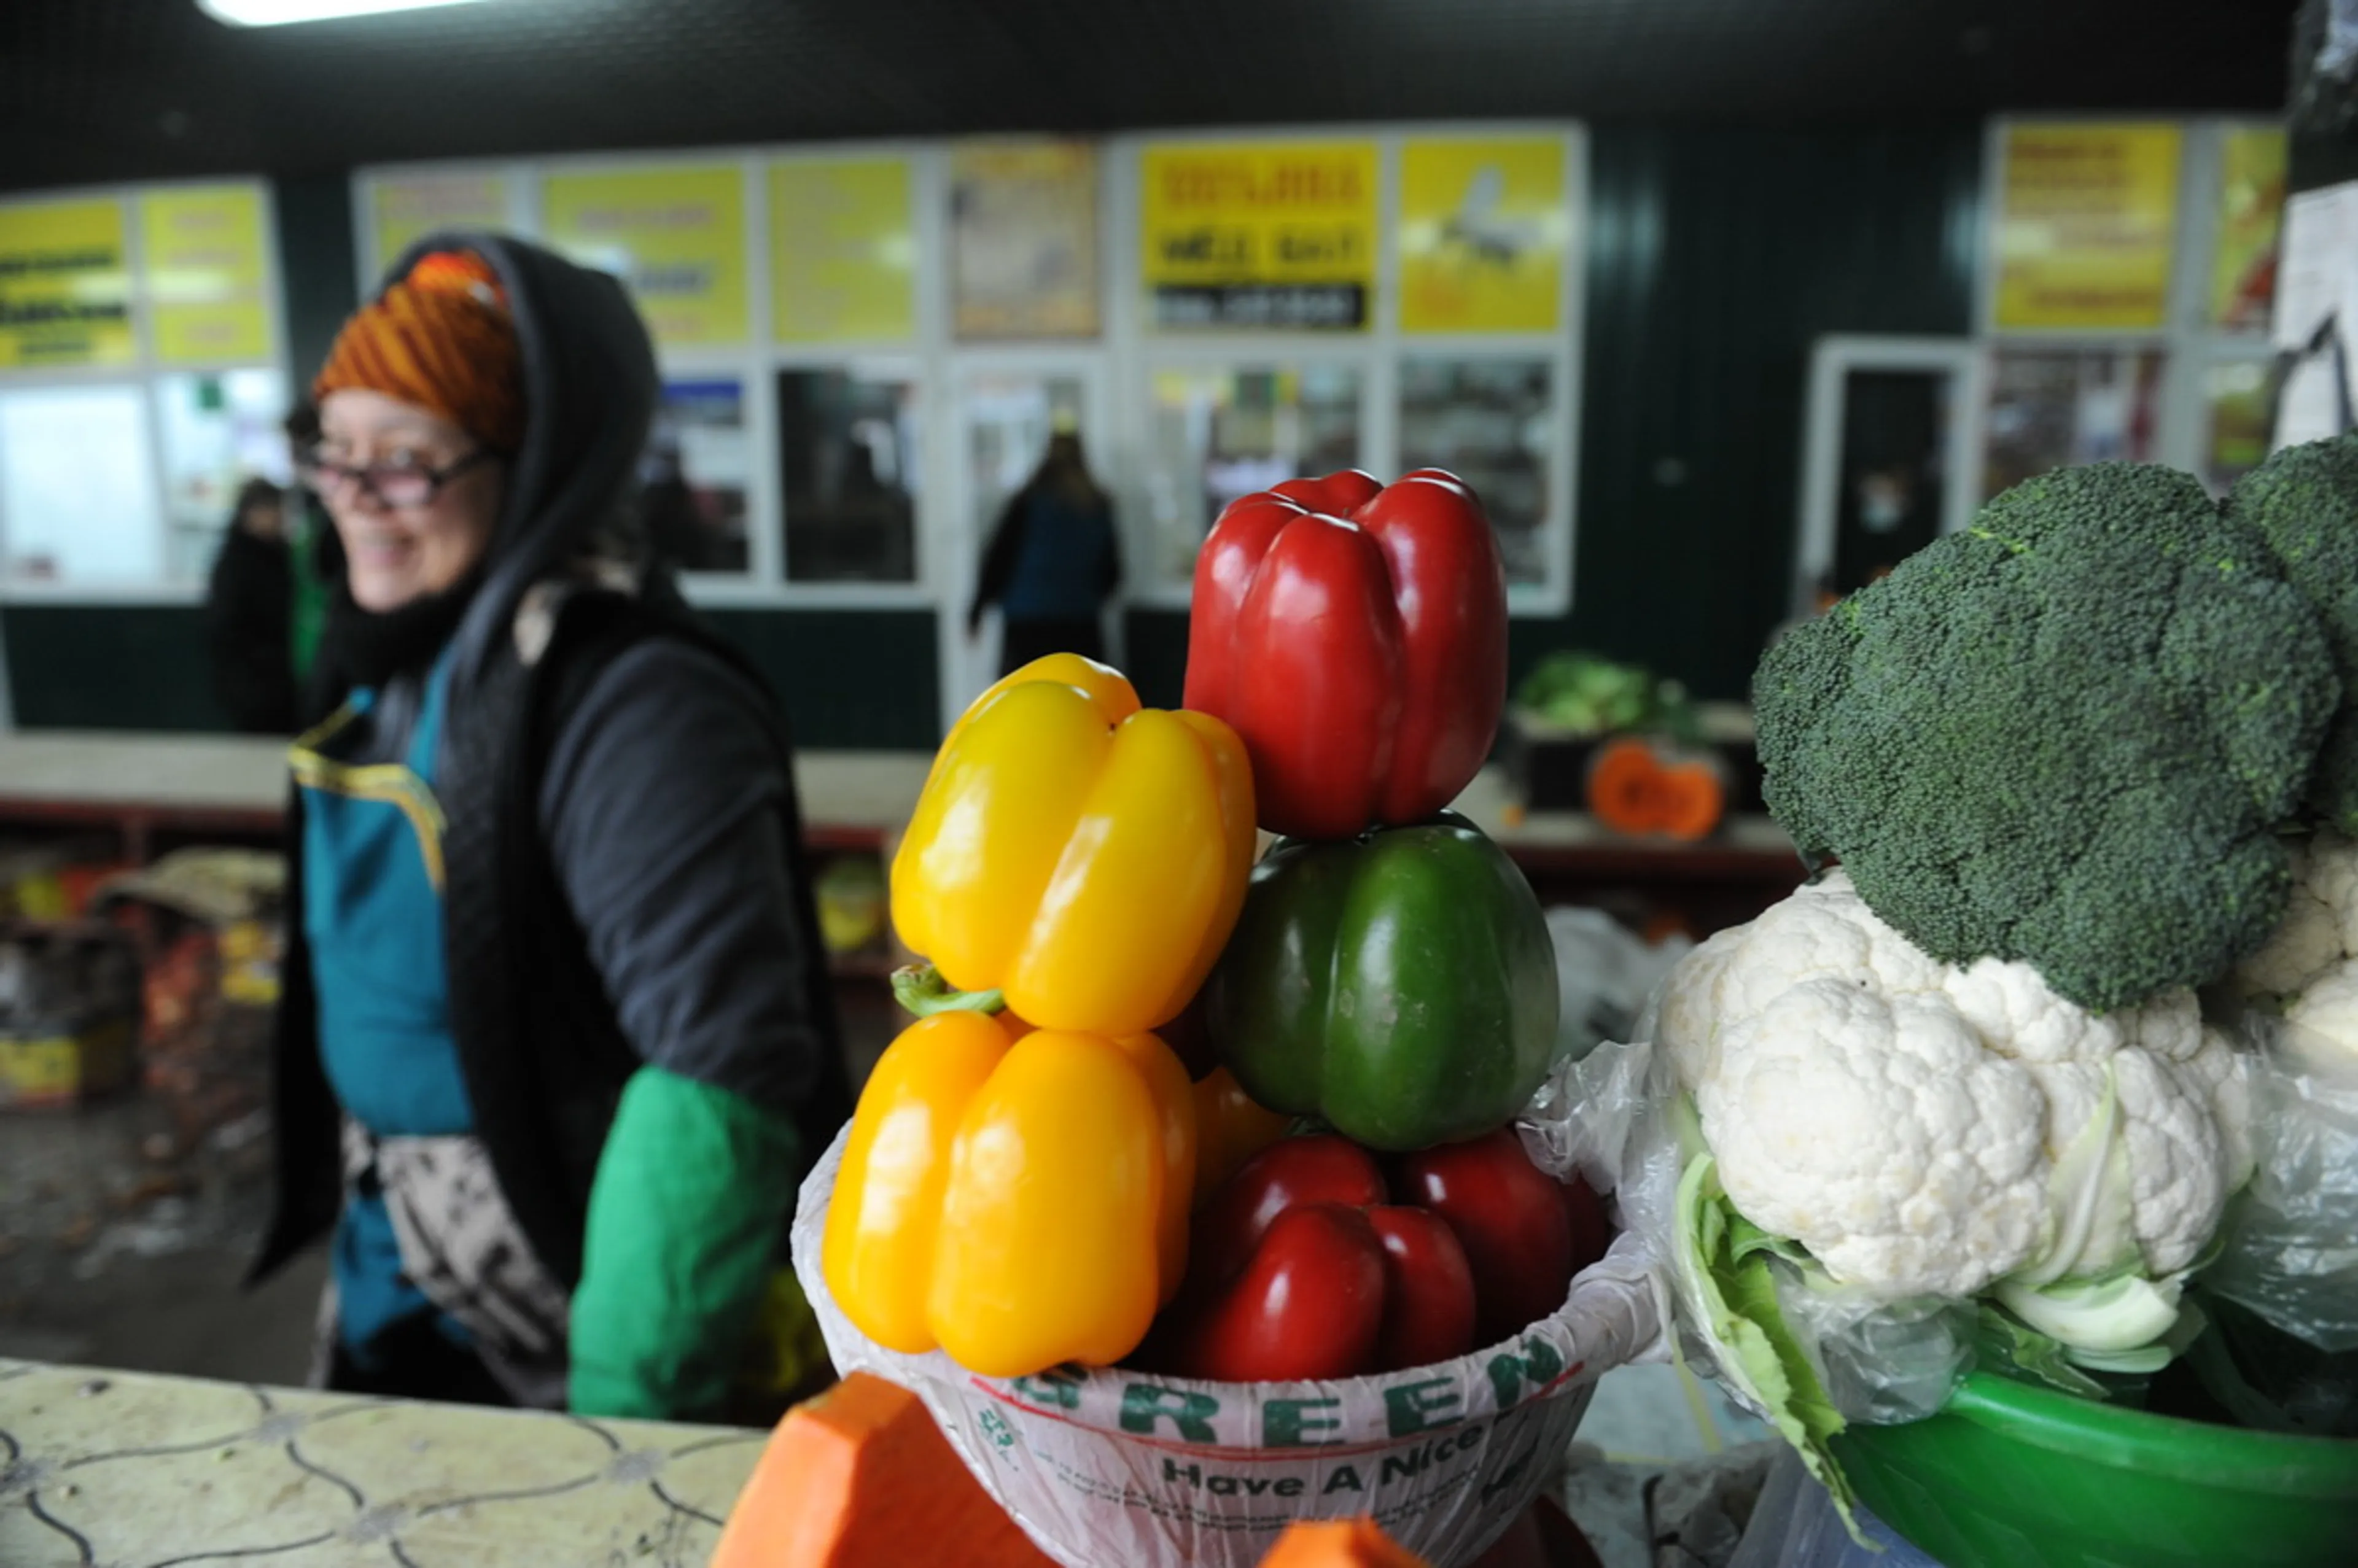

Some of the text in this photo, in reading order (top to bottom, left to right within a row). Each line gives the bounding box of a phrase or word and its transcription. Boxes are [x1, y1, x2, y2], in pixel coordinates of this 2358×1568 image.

[1163, 1457, 1305, 1497] Have
[1322, 1465, 1364, 1494] A
[1381, 1426, 1483, 1485] Nice
